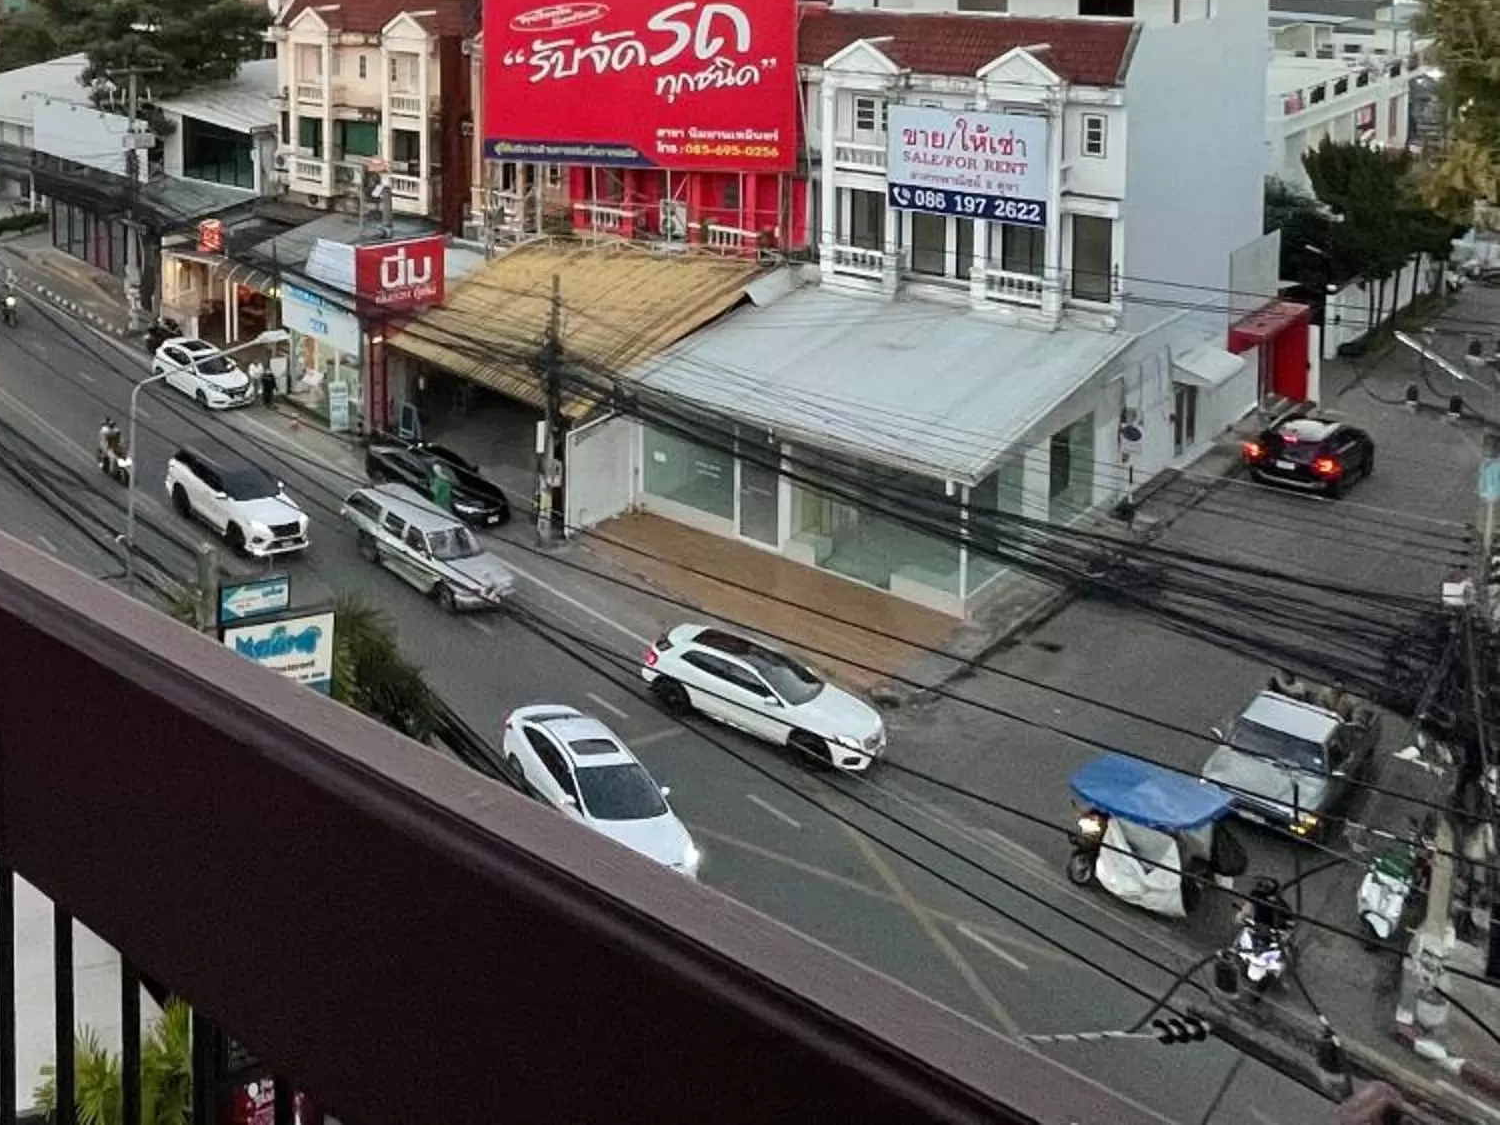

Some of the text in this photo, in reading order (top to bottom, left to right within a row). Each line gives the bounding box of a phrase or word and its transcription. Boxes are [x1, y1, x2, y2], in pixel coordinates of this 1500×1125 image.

[902, 118, 1028, 157] ขาย/ให้เช่า
[903, 150, 1029, 176] SALE/FOR RENT
[914, 189, 1041, 222] 086 197 2622
